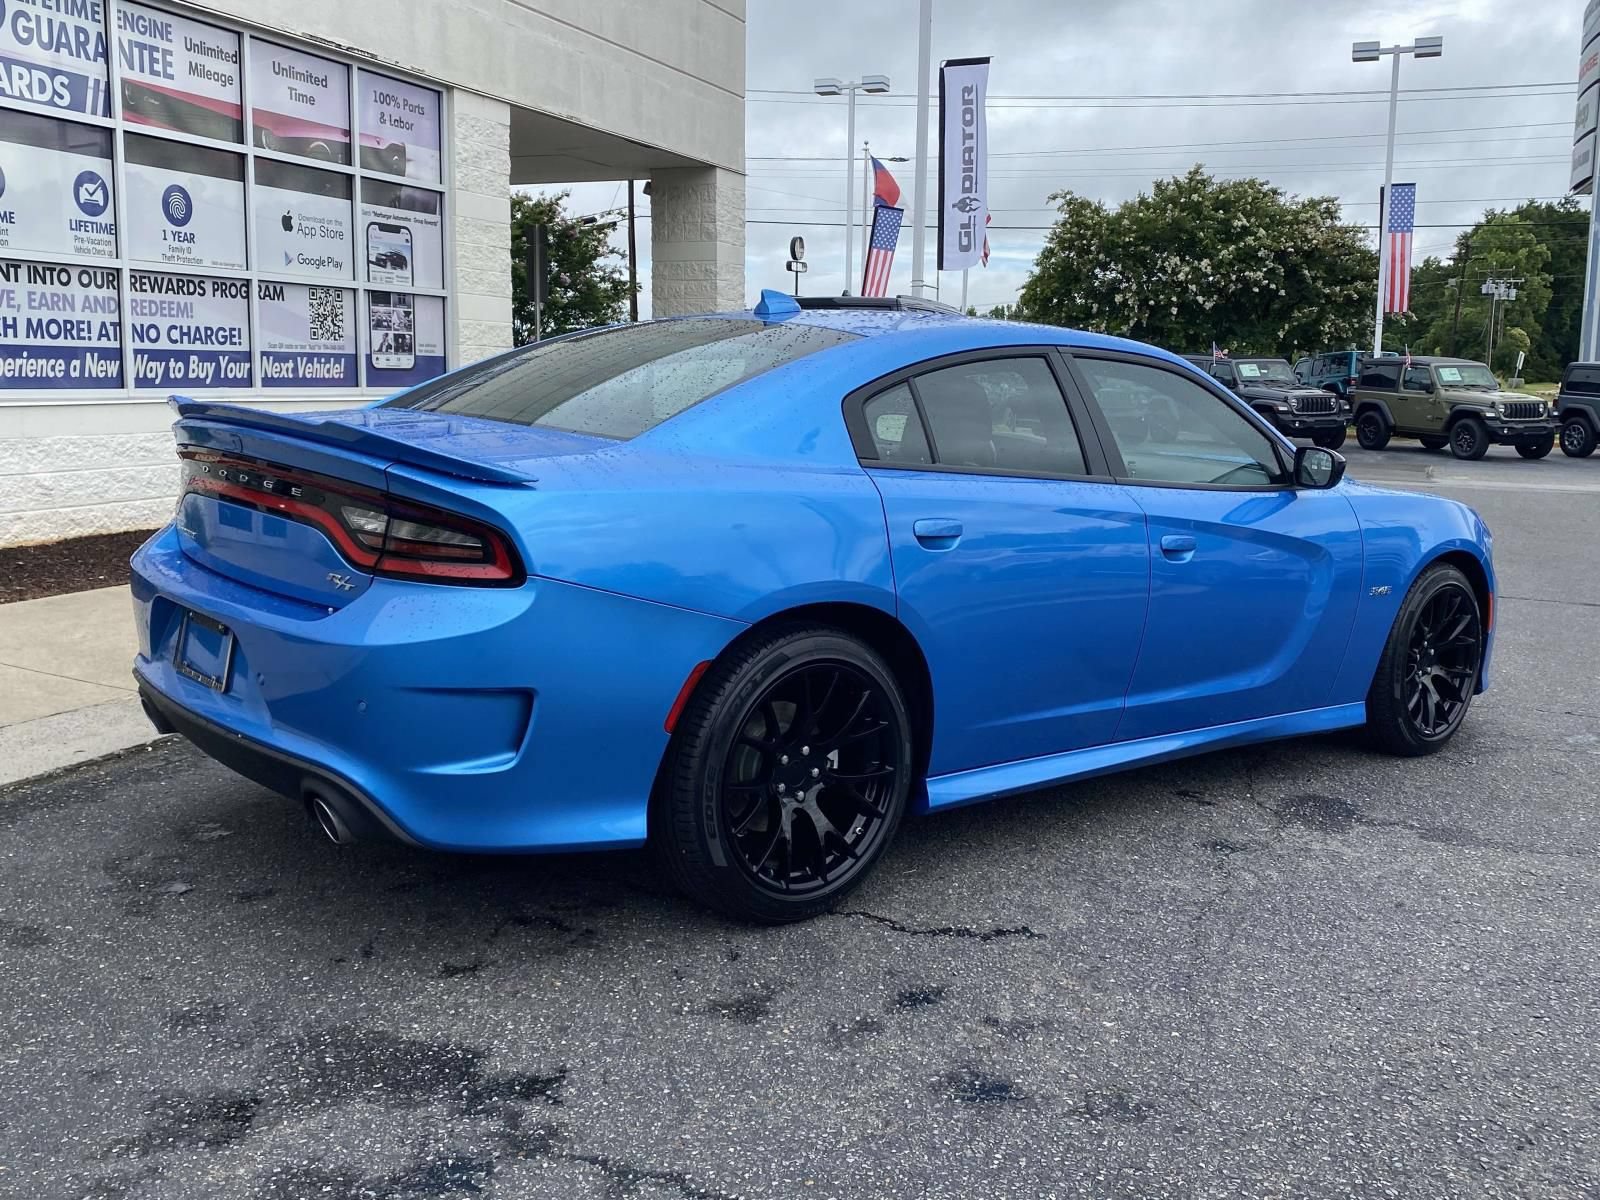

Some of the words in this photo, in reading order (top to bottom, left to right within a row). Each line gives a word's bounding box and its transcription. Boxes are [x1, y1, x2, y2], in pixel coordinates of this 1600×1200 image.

[117, 9, 173, 43] ENGINE
[184, 36, 238, 64] Unlimited
[189, 60, 234, 87] Mileage
[272, 61, 328, 88] Unlimited
[288, 86, 316, 105] Time
[373, 90, 400, 109] 100%
[403, 98, 425, 115] Parts
[379, 112, 386, 124] &
[389, 114, 414, 131] Labor
[69, 219, 115, 235] LIFETIME
[162, 229, 167, 240] 1
[171, 230, 195, 244] YEAR
[297, 222, 317, 239] App
[320, 225, 344, 240] Store
[74, 235, 112, 247] Pre-Vacation
[169, 244, 185, 255] Family
[177, 255, 203, 264] Protection
[297, 253, 326, 269] Google
[327, 256, 343, 271] Play
[27, 265, 71, 286] INTO
[78, 269, 117, 290] OUR
[129, 274, 206, 297] REWARDS
[27, 291, 75, 312] EARN
[81, 295, 118, 314] AND
[130, 298, 194, 319] REDEEM!
[0, 316, 18, 338] H
[26, 317, 92, 341] MORE!
[97, 321, 120, 341] AT
[131, 323, 161, 343] NO
[167, 325, 242, 346] CHARGE!
[70, 359, 80, 378] a
[84, 352, 120, 378] New
[135, 354, 165, 384] Way
[169, 358, 184, 379] to
[188, 355, 216, 384] Buy
[219, 355, 250, 379] Your
[261, 355, 294, 378] Next
[297, 356, 345, 379] Vehicle!
[202, 465, 302, 496] DODGE
